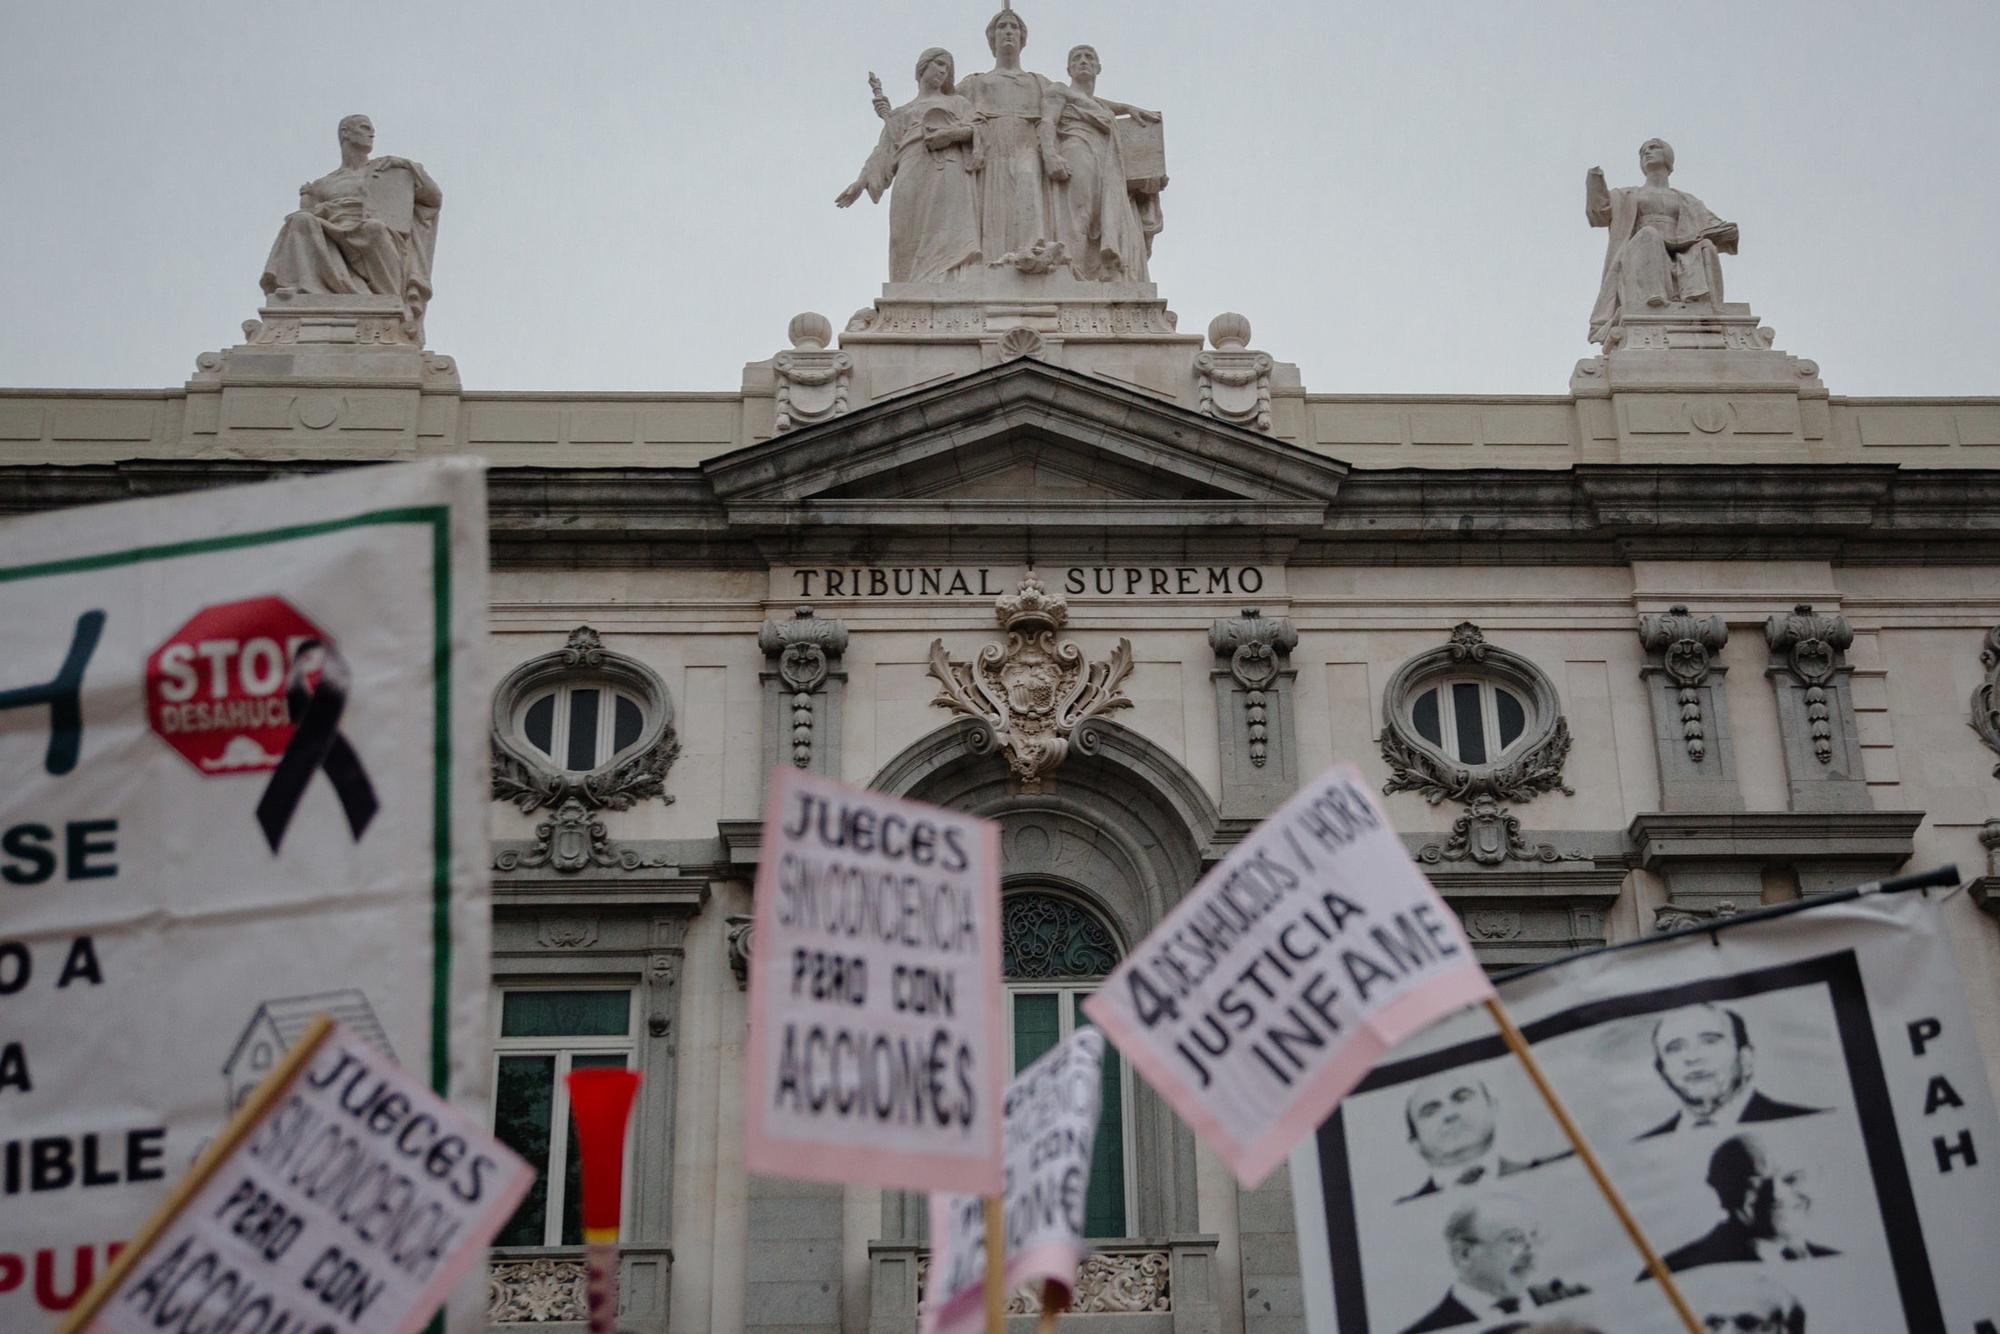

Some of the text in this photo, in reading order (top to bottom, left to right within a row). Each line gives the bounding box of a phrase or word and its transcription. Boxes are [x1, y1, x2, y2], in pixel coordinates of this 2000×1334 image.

[794, 566, 1264, 597] TRIBUNAL SUPREMO
[56, 936, 104, 988] A
[894, 965, 956, 1018] CON
[1175, 888, 1365, 1087] JUSTICIA
[1251, 904, 1460, 1085] INFAME
[1125, 966, 1181, 1028] 4
[775, 1023, 978, 1132] ACCIONES
[1907, 1017, 1979, 1174] PAH
[5, 1128, 167, 1195] IBLE
[0, 1243, 132, 1311] PU
[302, 1244, 386, 1324] CON
